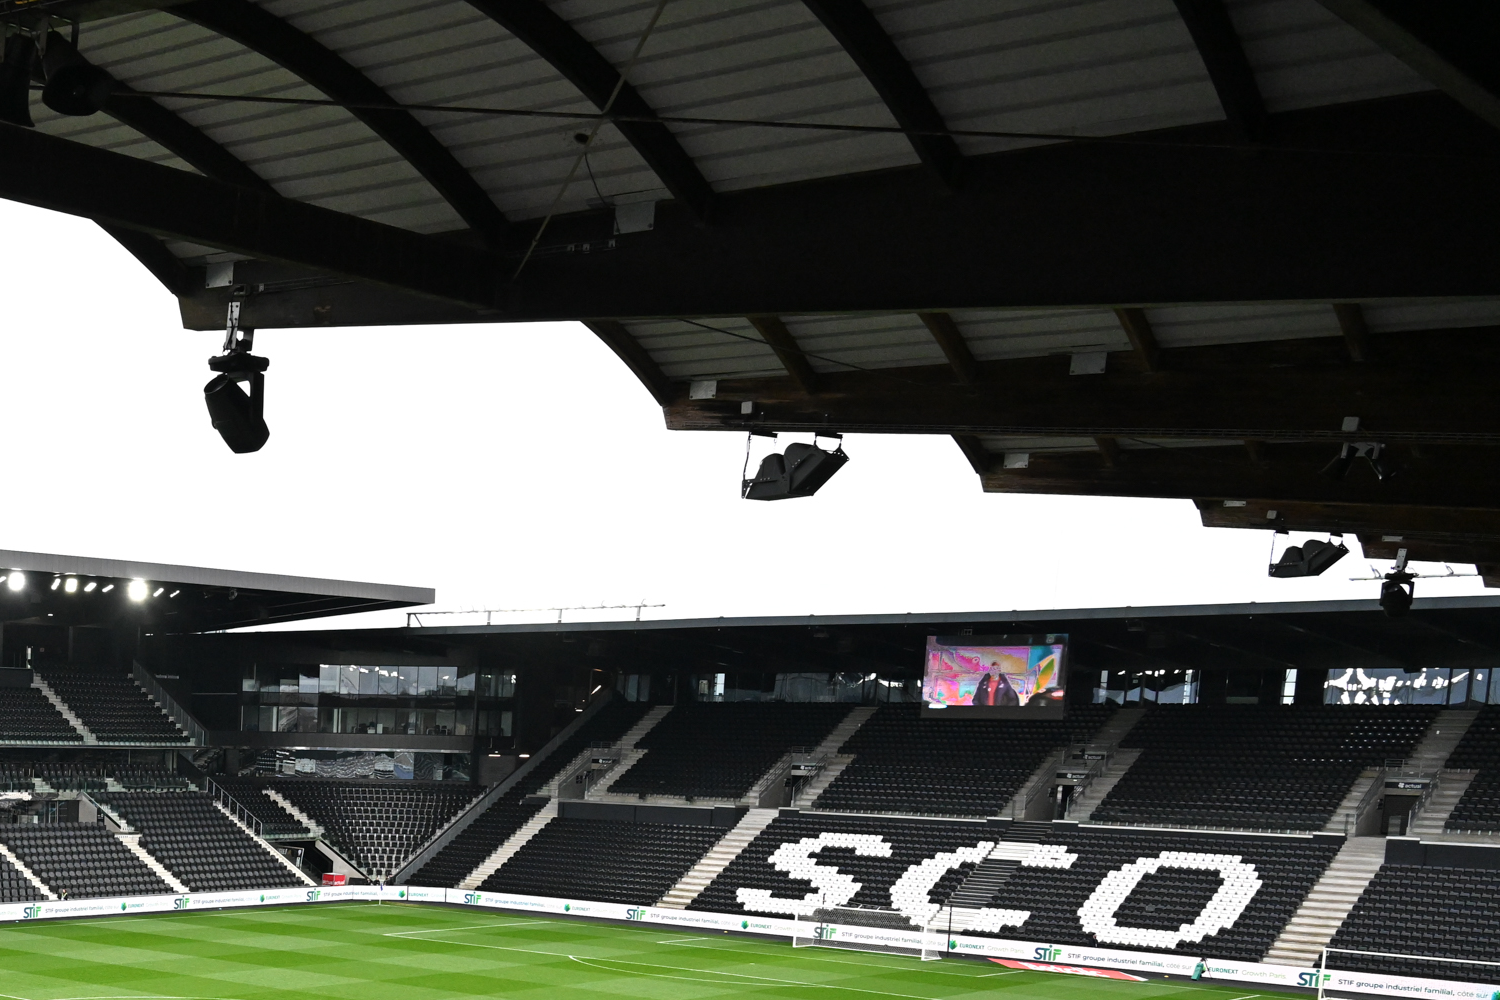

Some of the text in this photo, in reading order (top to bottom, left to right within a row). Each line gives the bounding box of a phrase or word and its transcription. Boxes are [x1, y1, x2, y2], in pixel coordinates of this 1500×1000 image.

[736, 832, 1262, 948] SCO
[875, 934, 900, 942] industriel
[959, 942, 985, 950] EURONEXT
[1082, 954, 1105, 963] groupe
[1107, 956, 1137, 964] industriel
[1138, 959, 1164, 968] familial,
[1241, 969, 1266, 978] Growth
[1356, 981, 1384, 990] groupe
[1385, 983, 1422, 992] industriel
[1424, 986, 1455, 996] familial,
